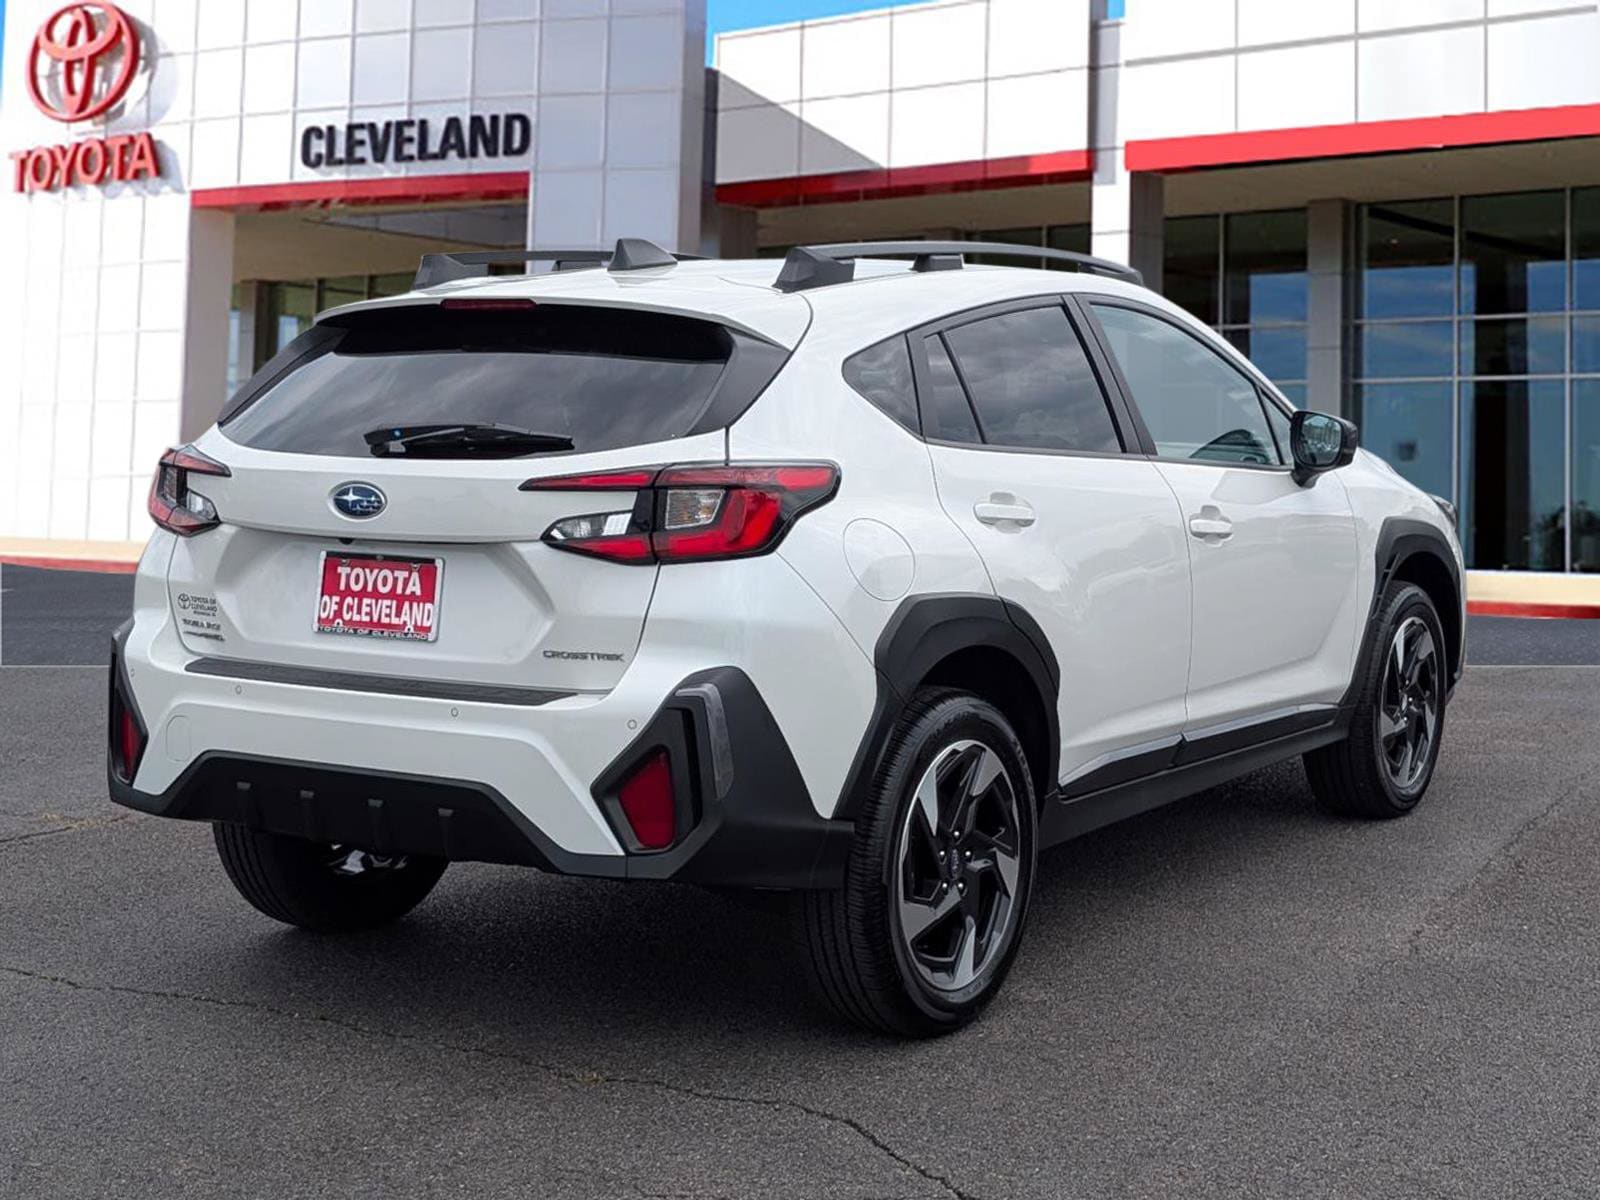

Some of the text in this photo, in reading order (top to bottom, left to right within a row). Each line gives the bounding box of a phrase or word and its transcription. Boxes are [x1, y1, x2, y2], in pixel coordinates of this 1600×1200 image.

[301, 114, 531, 168] CLEVELAND
[9, 132, 160, 192] TOYOTA
[338, 567, 421, 595] TOYOTA
[320, 595, 434, 628] OF CLEVELAND
[319, 625, 354, 634] TOYOTA
[372, 631, 428, 640] CLEVELAND
[543, 650, 625, 662] CROSSTREK
